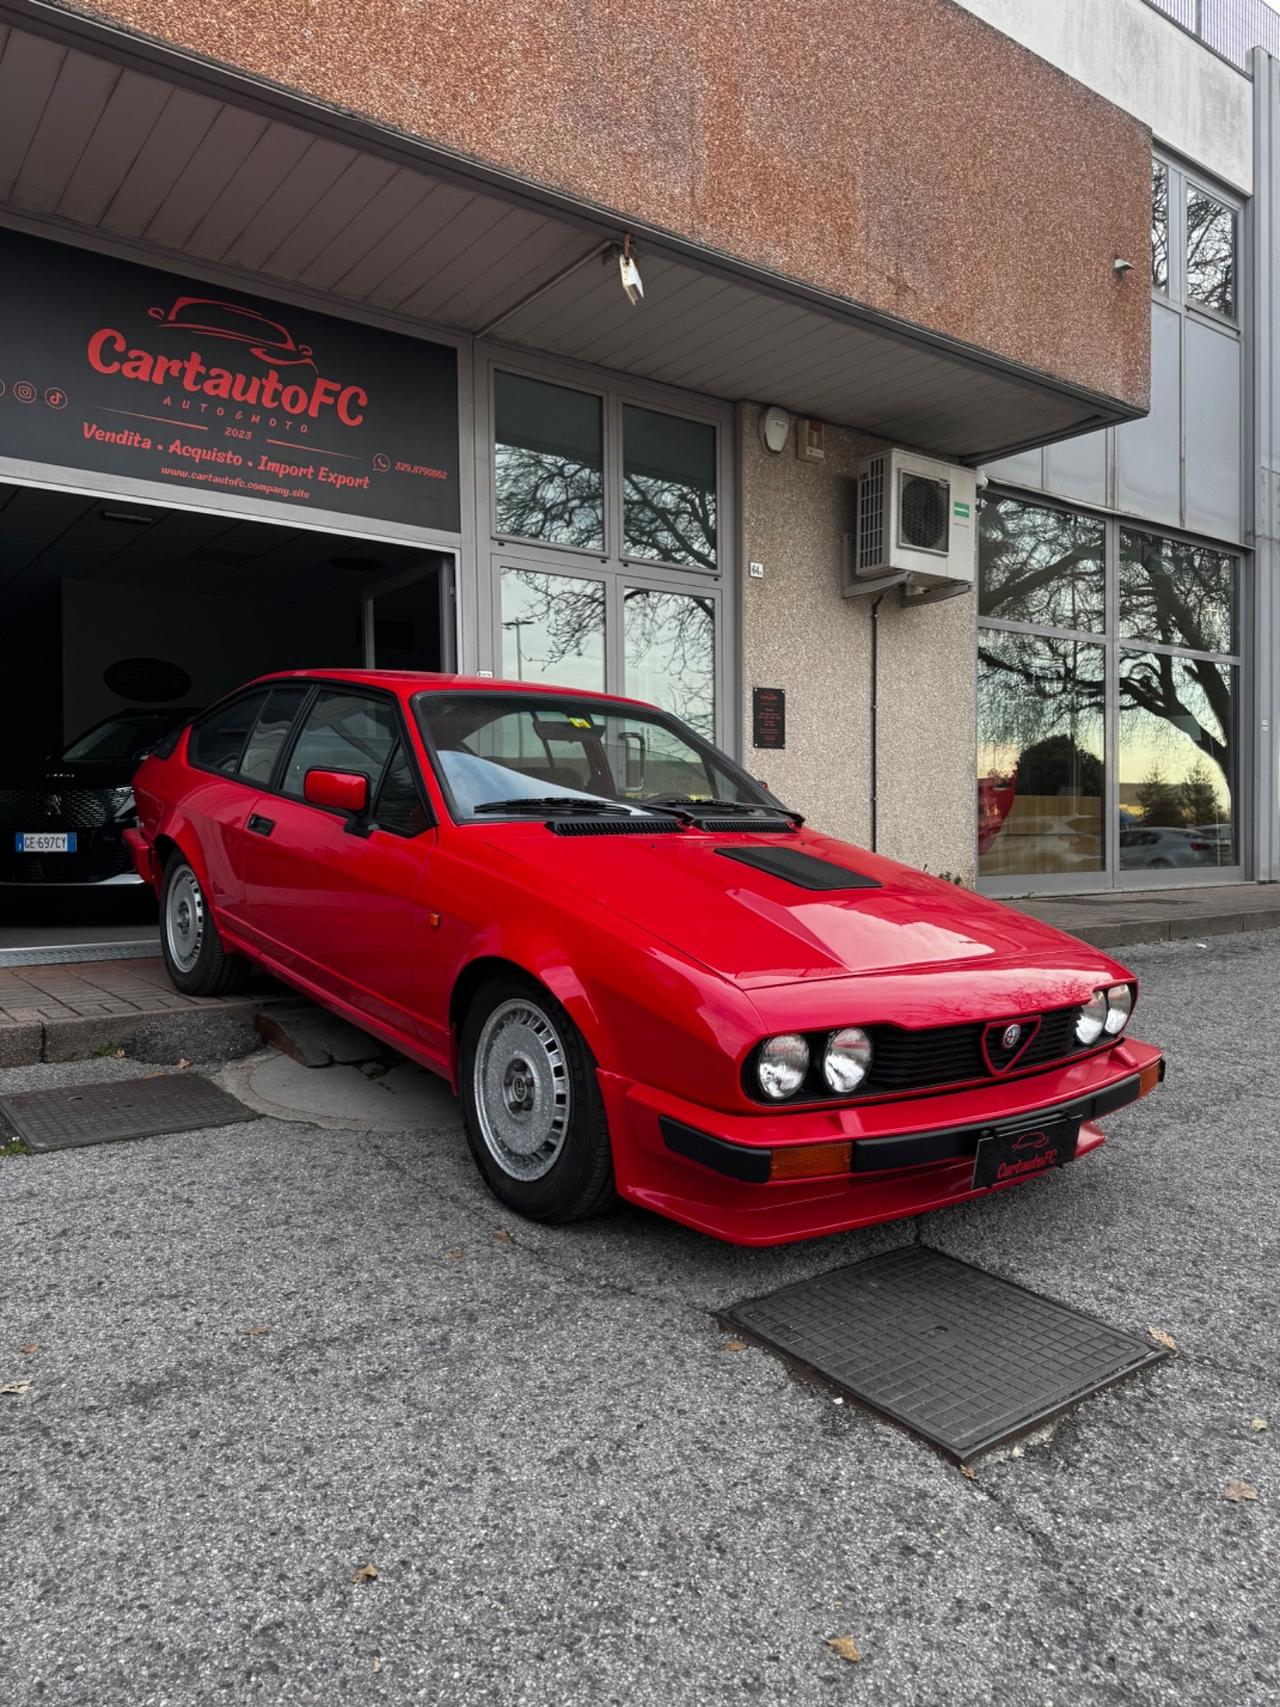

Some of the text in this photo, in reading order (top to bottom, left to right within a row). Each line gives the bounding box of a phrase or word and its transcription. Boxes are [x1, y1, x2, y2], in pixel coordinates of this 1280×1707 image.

[87, 328, 368, 427] CartautoFC
[82, 422, 370, 490] Vendita Acquisto Import Export
[224, 427, 253, 440] 2023
[997, 1148, 1058, 1179] CartautoFC
